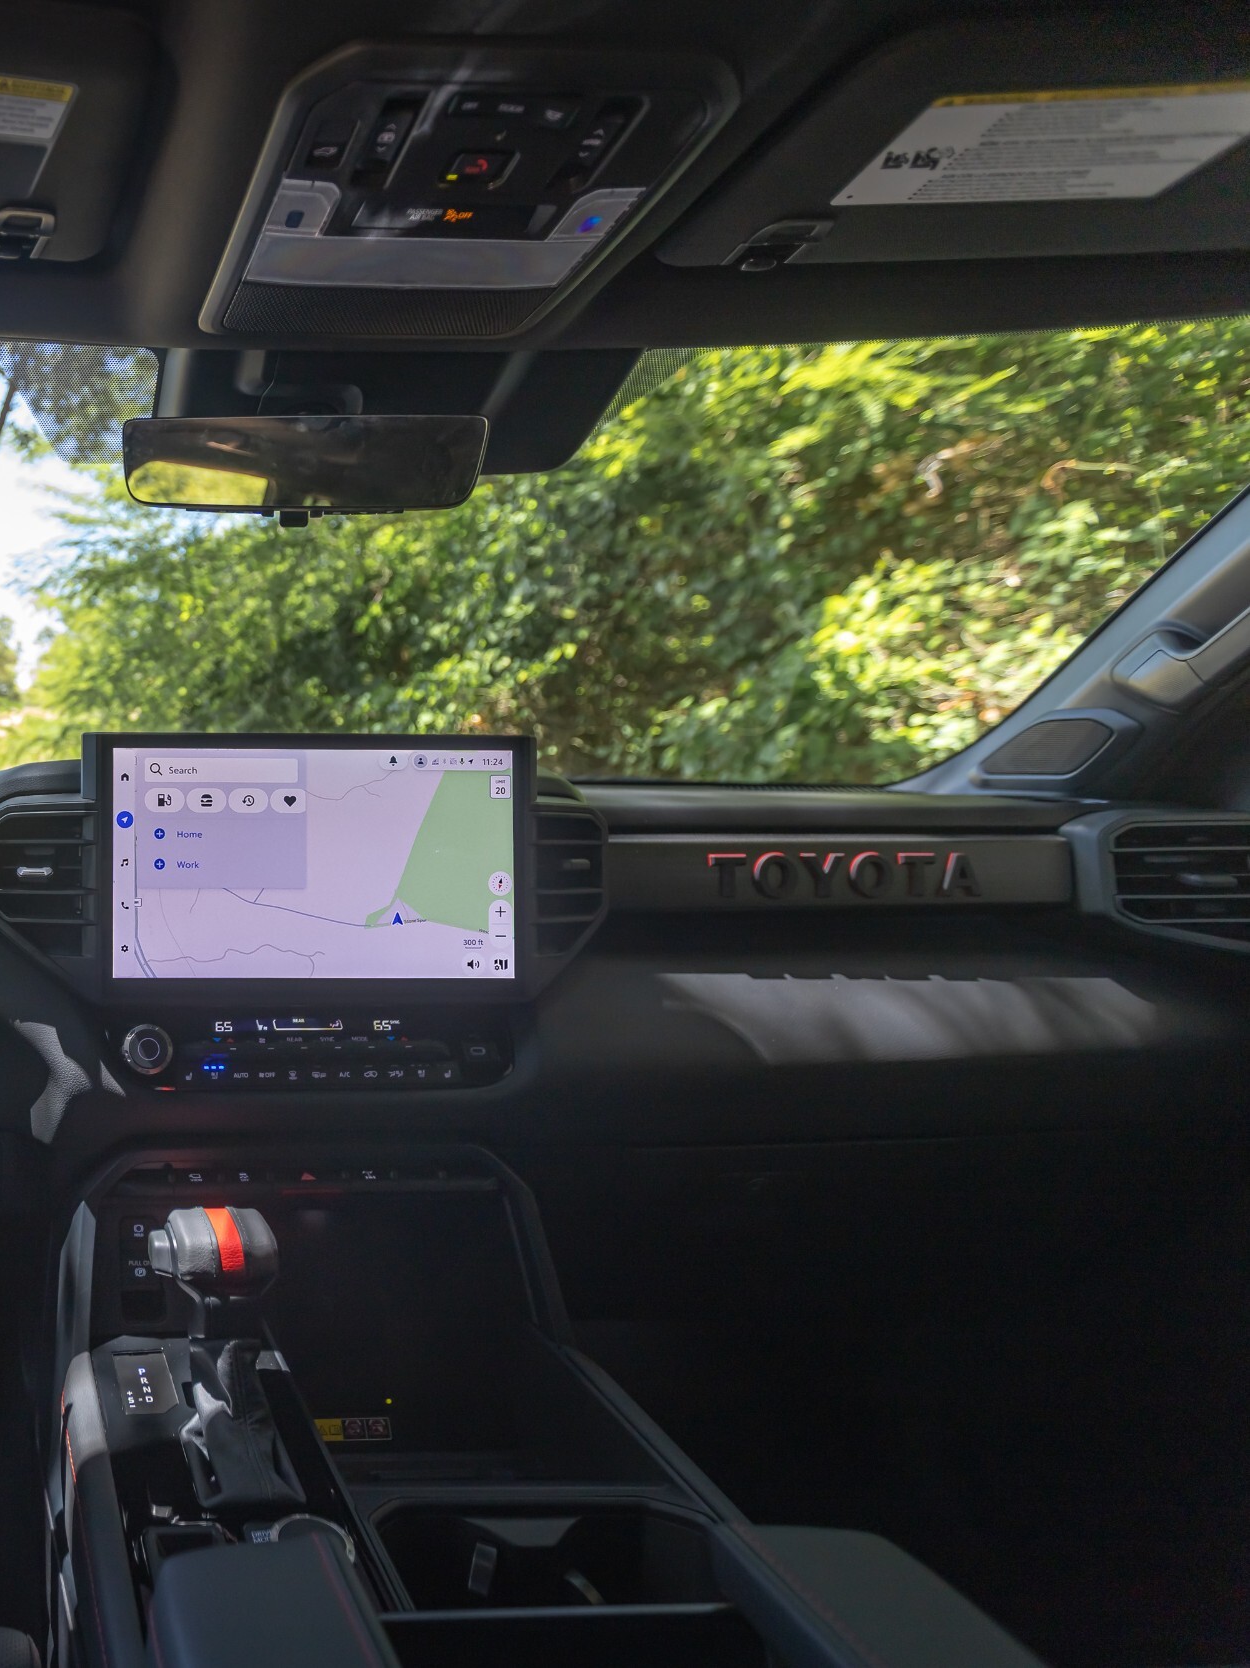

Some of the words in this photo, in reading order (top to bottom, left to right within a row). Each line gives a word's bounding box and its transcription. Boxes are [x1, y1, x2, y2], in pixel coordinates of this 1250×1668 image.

[168, 766, 198, 774] Search
[708, 850, 982, 898] TOYOTA
[215, 1022, 232, 1032] 65
[373, 1020, 391, 1030] 65
